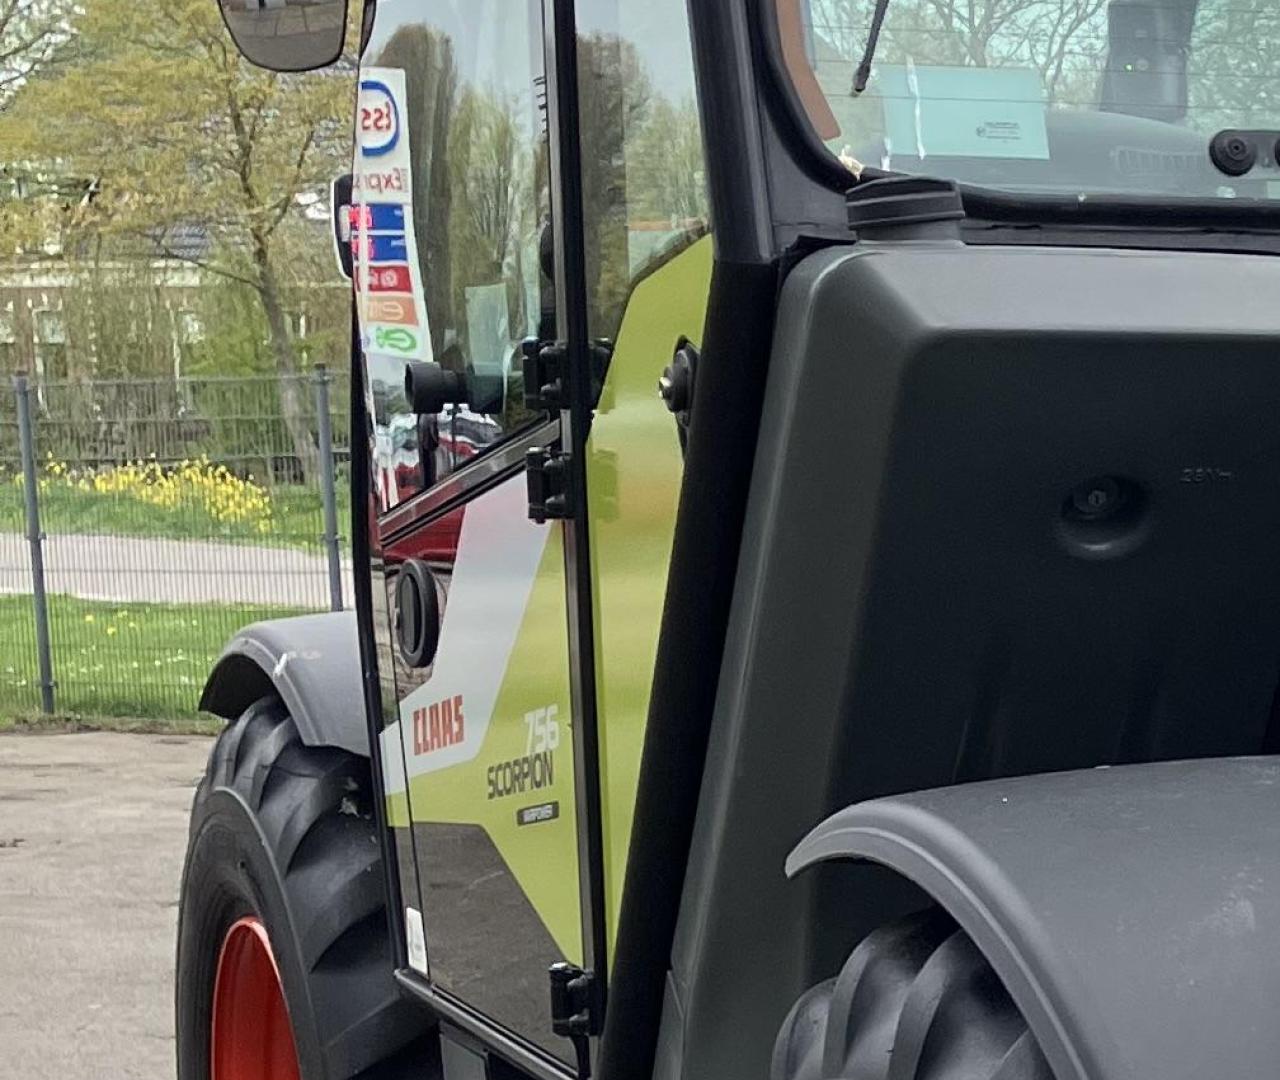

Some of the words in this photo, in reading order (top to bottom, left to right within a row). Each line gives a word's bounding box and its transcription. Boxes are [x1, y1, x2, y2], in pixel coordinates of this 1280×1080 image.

[413, 694, 465, 757] CLAAS
[524, 703, 560, 756] 756
[487, 750, 554, 800] SCORPION
